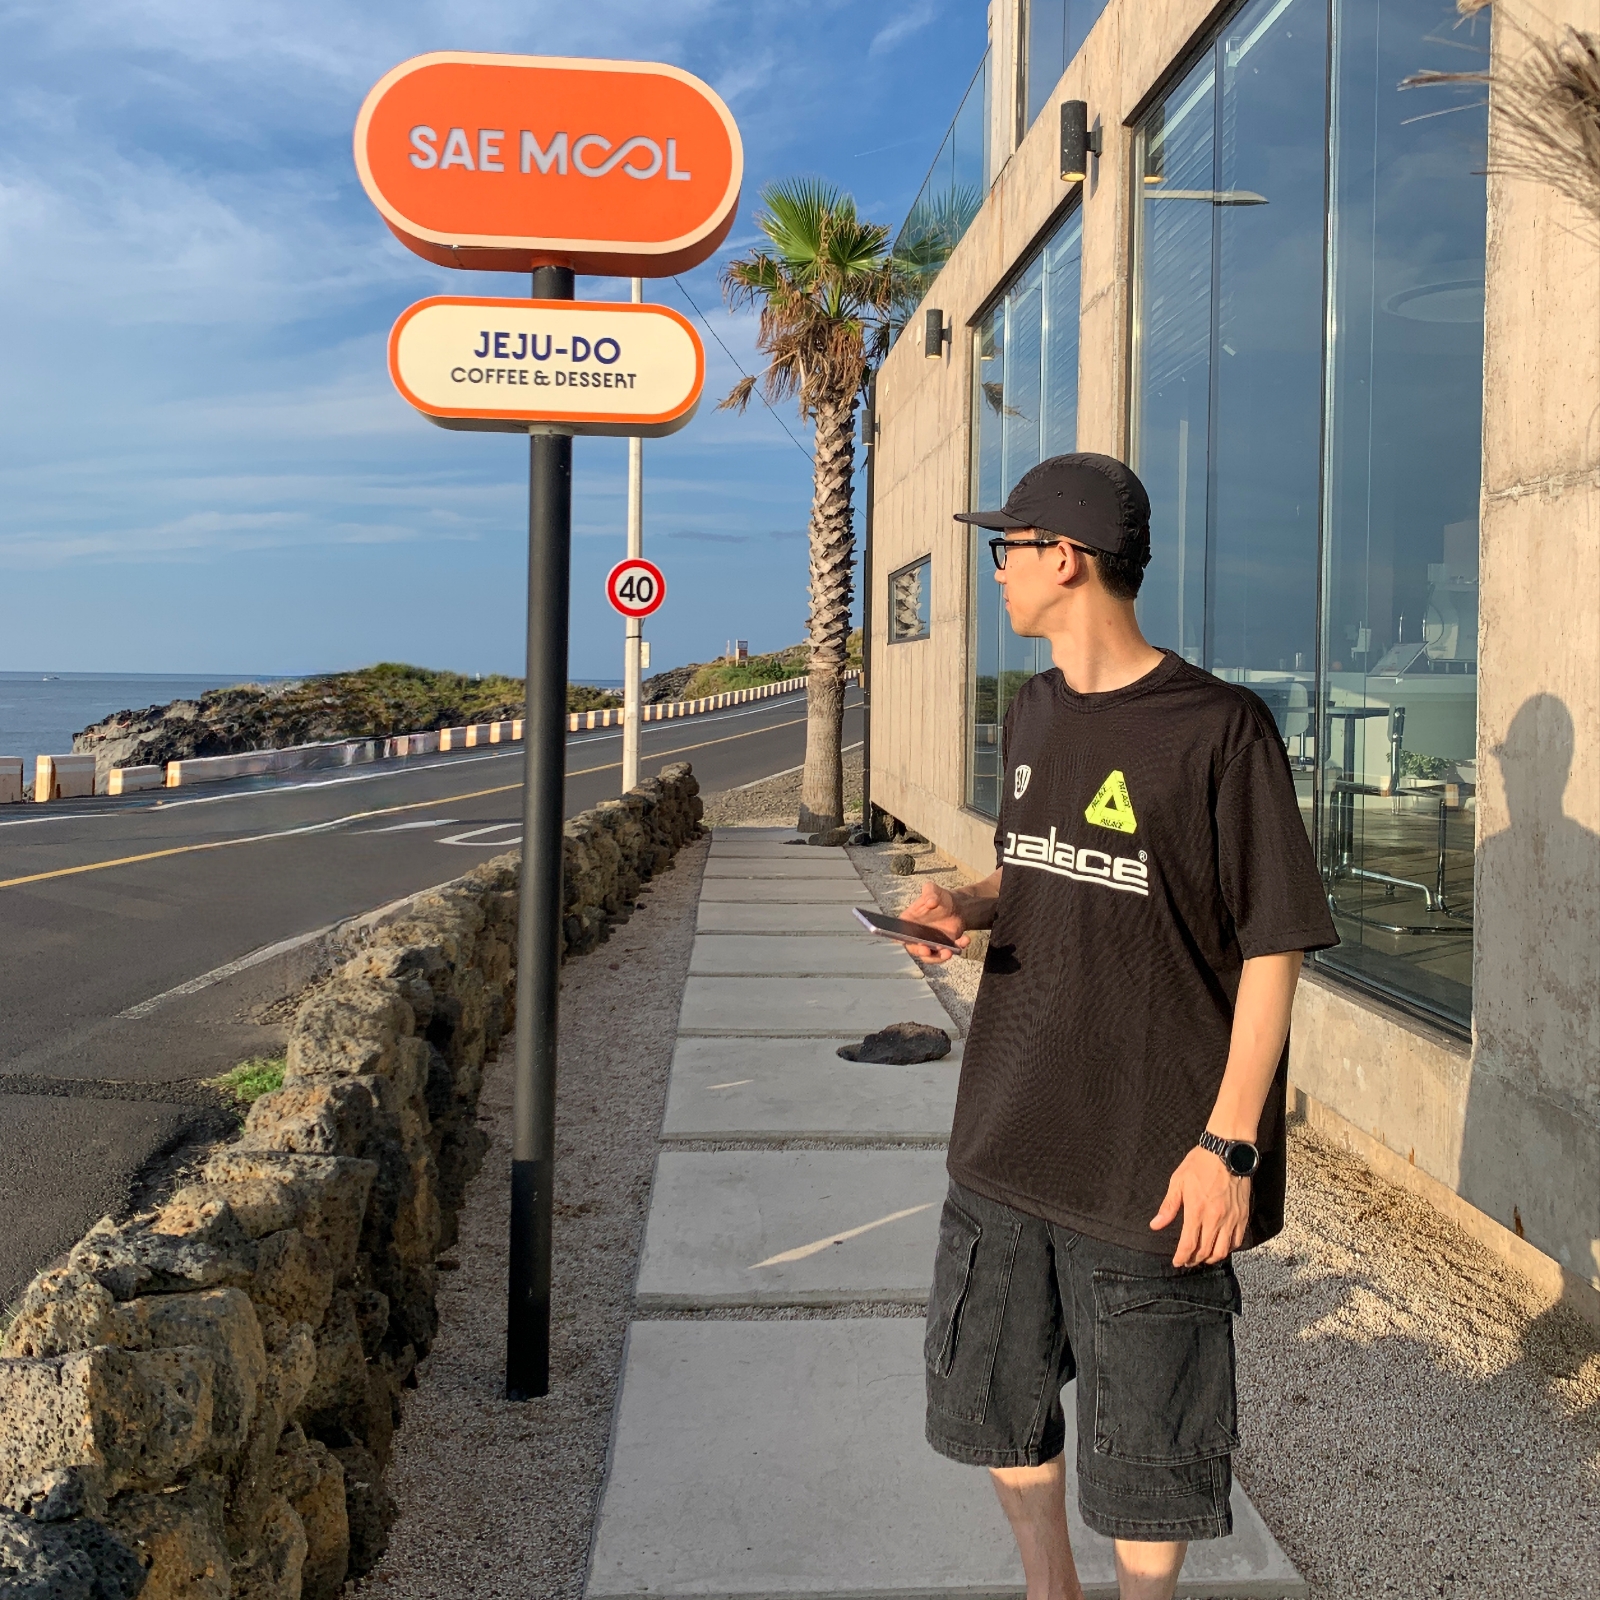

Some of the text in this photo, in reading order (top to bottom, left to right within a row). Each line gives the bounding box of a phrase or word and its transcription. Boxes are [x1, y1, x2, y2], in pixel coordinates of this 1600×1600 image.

[407, 124, 692, 181] SAE MOOL
[473, 330, 622, 365] JEJU-DO
[450, 366, 638, 389] COFFEE & DESSERT
[618, 575, 654, 603] 40
